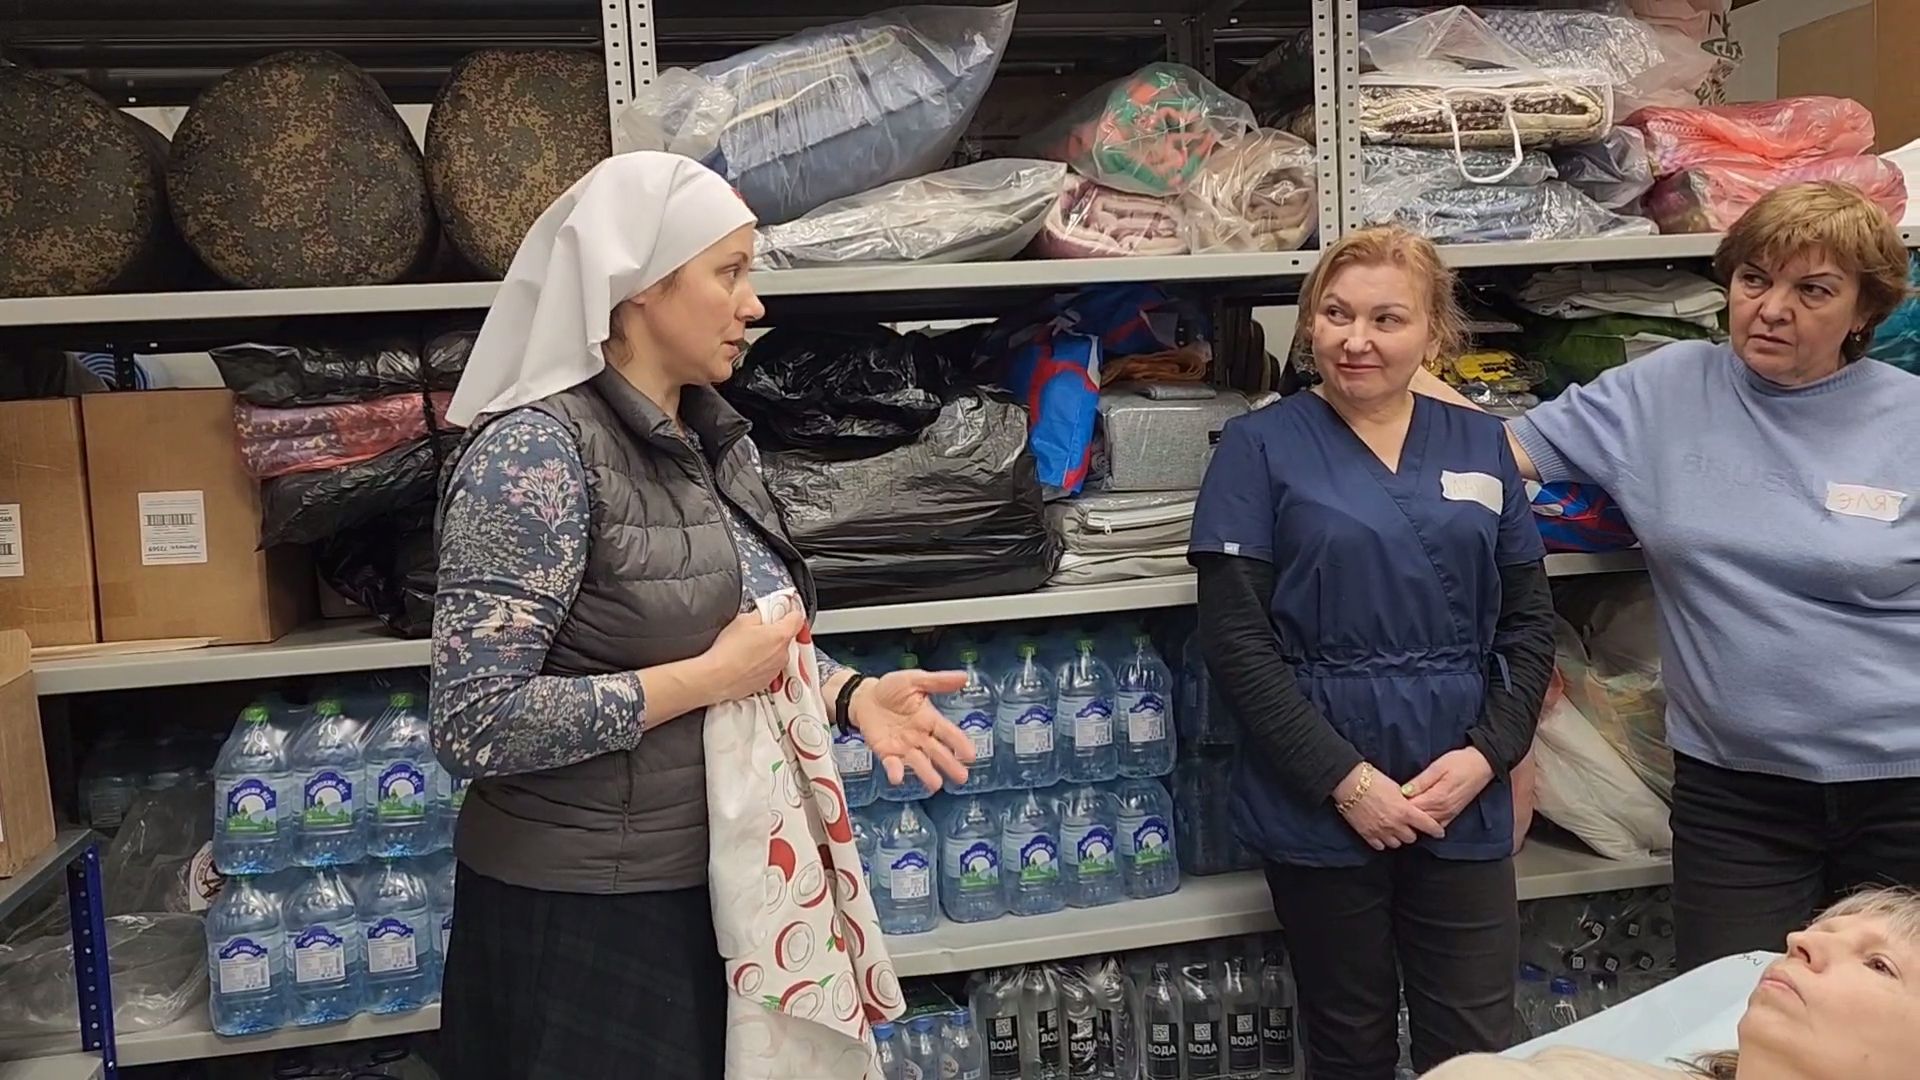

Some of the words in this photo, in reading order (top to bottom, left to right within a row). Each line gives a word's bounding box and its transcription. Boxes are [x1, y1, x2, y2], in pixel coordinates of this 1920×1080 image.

[1230, 1034, 1259, 1046] ВОДА
[1263, 1028, 1292, 1040] ВОДА
[990, 1039, 1018, 1051] ВОДА
[1070, 1040, 1098, 1052] ВОДА
[1148, 1043, 1177, 1056] ВОДА
[1188, 1042, 1218, 1055] ВОДА
